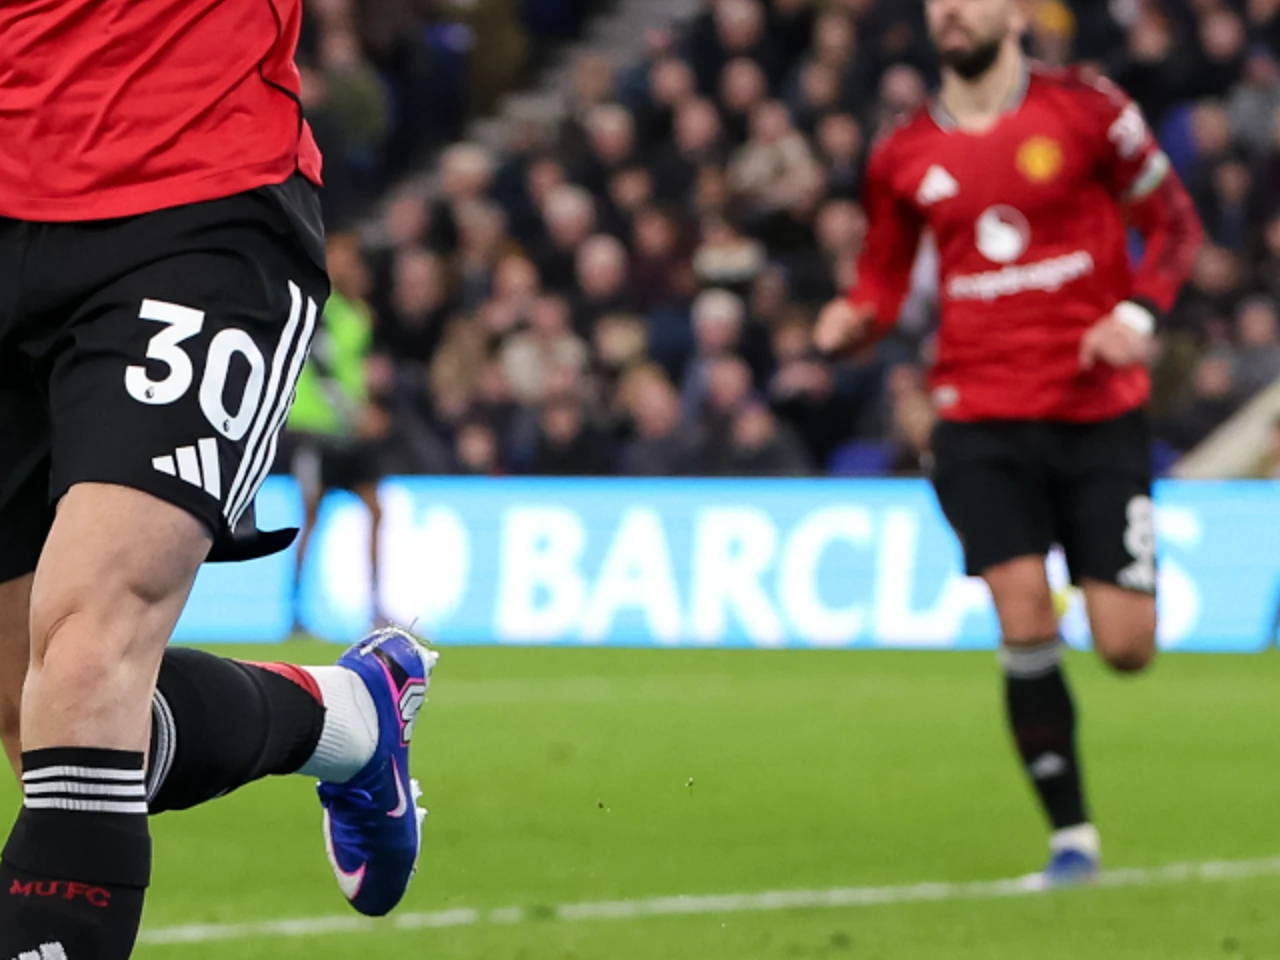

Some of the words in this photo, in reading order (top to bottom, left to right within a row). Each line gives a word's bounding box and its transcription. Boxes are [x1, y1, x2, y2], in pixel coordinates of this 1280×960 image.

[124, 297, 266, 442] 30
[1123, 493, 1156, 560] 8
[8, 879, 111, 907] MUFC
